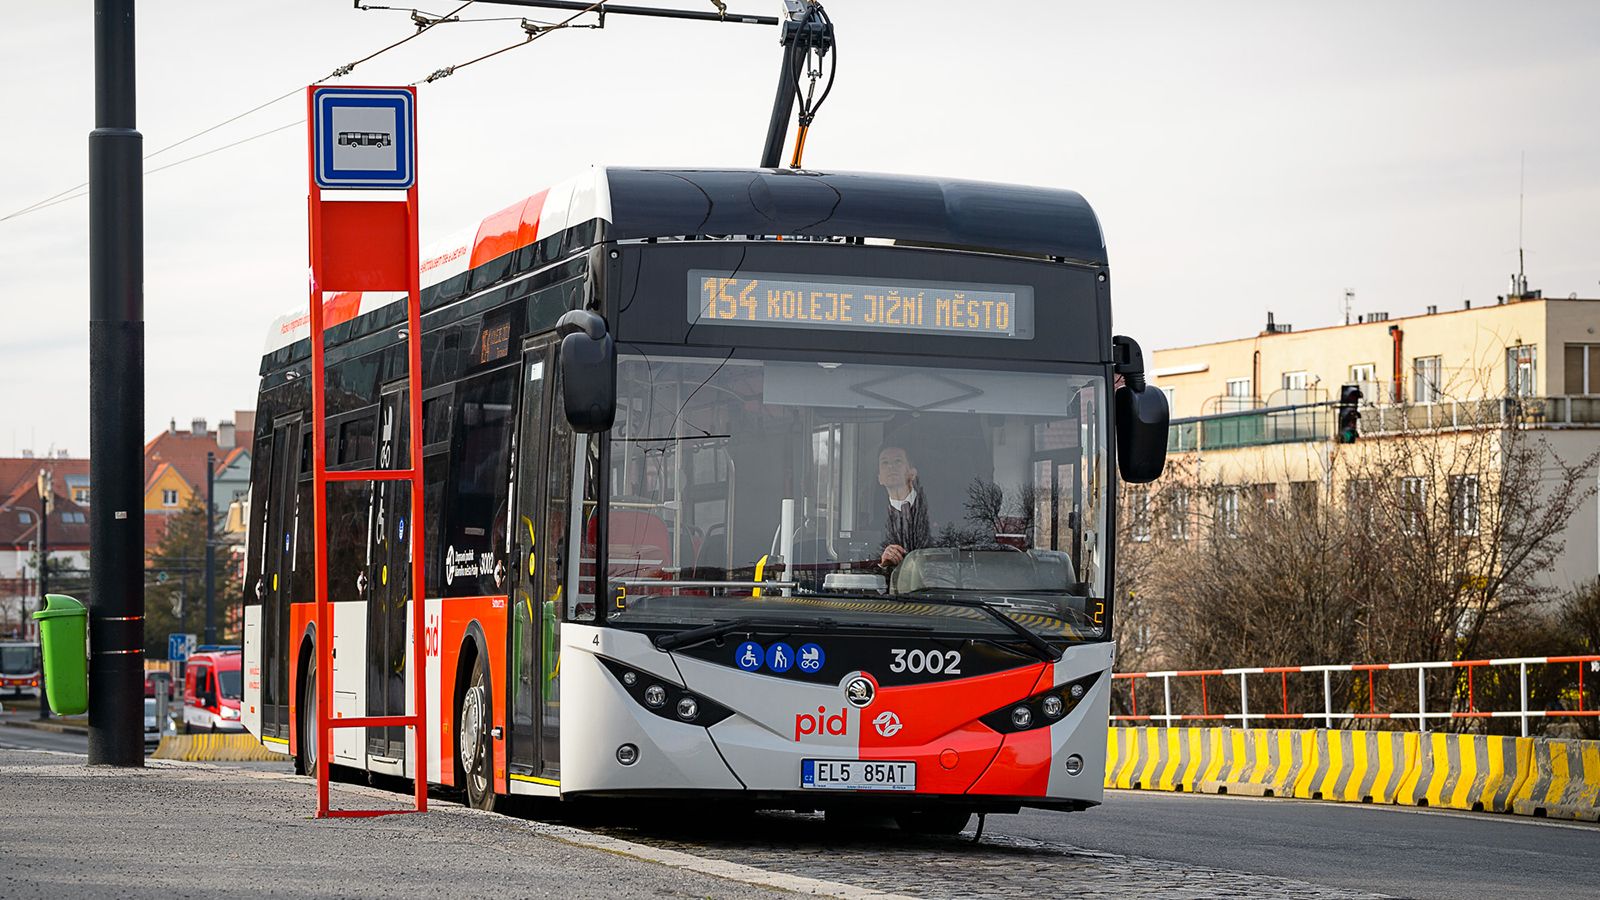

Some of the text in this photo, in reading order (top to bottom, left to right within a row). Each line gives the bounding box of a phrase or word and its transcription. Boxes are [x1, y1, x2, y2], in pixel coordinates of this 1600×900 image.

[704, 277, 1009, 329] 154 KOLEJE JIŽNÍ MĚSTO
[616, 587, 626, 608] 2
[1094, 603, 1104, 623] 2
[592, 634, 600, 646] 4
[889, 648, 961, 674] 3002
[795, 705, 847, 742] pid
[818, 763, 907, 783] EL5 85AT
